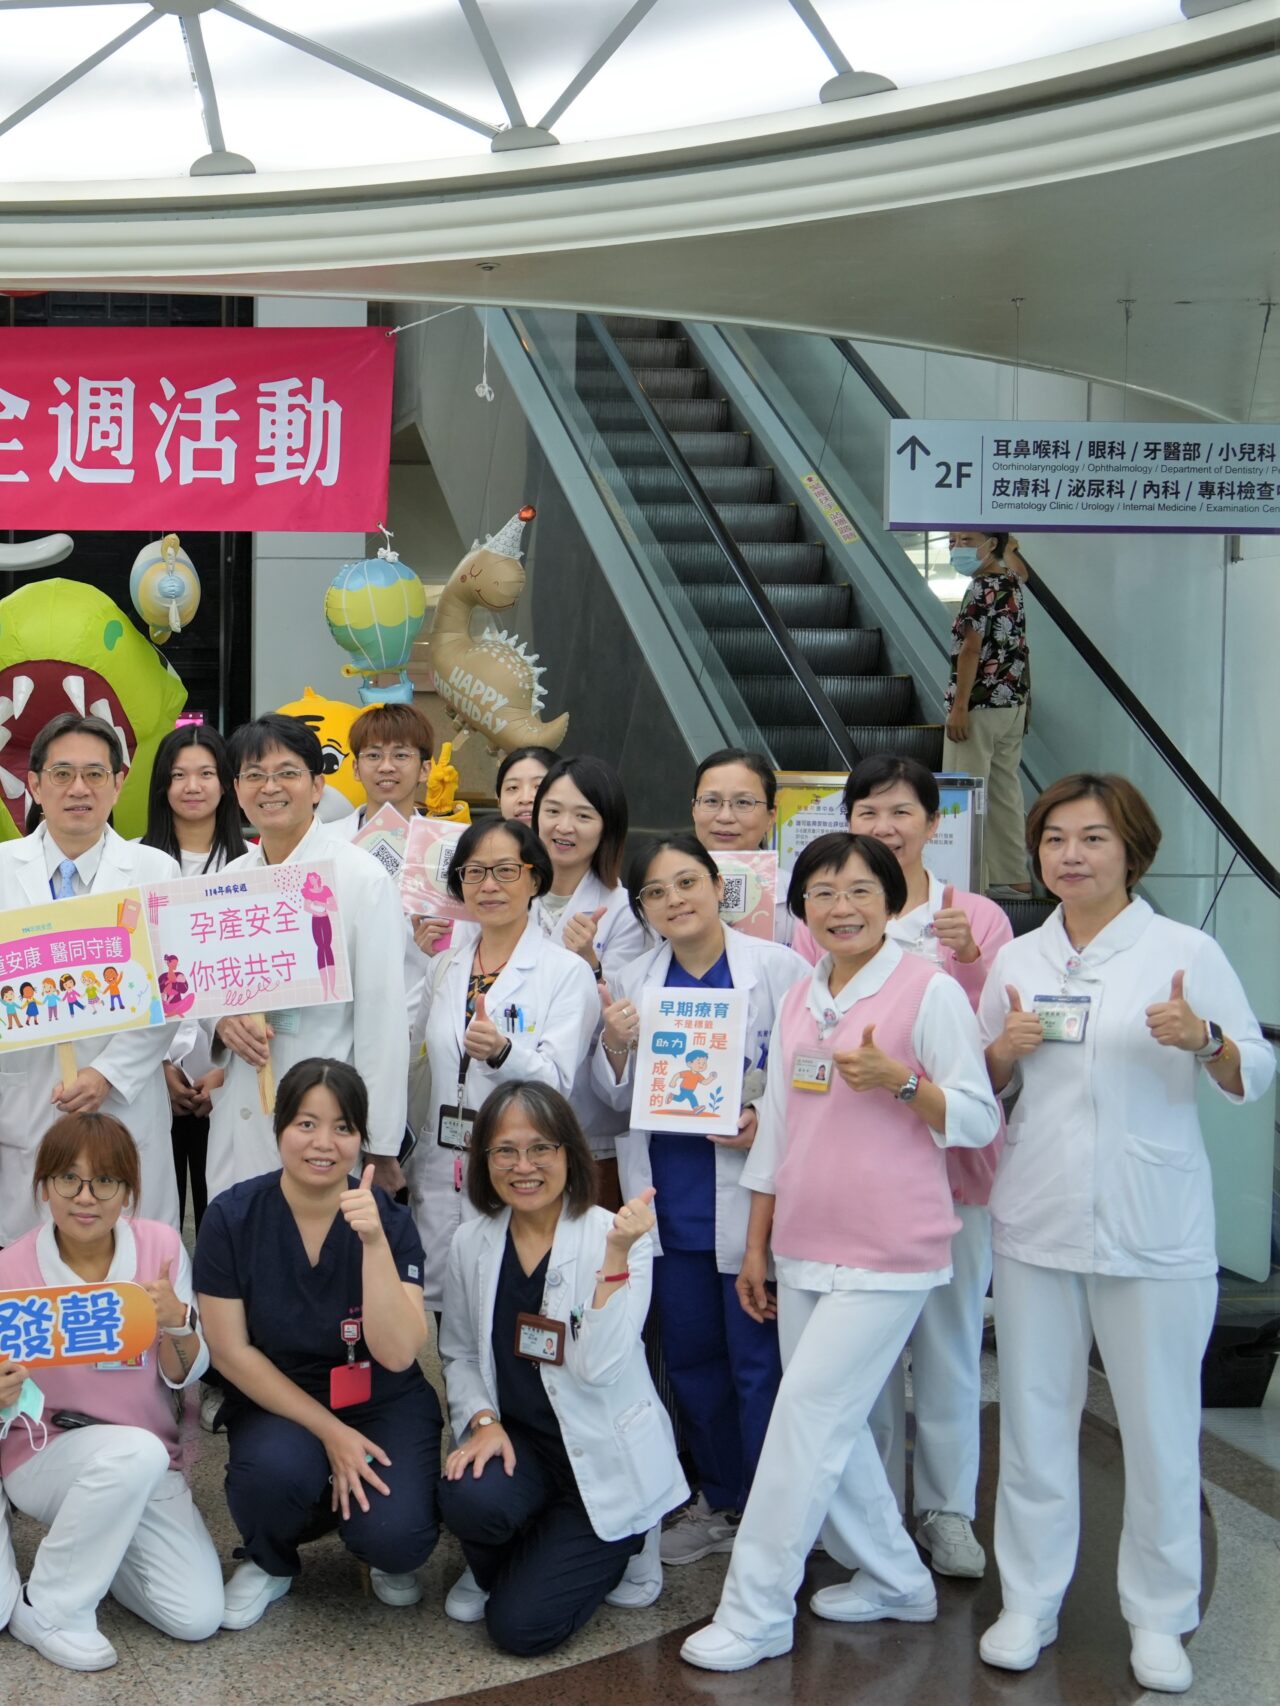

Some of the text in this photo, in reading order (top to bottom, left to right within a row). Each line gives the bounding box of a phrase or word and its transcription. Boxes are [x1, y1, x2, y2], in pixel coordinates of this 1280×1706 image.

[993, 439, 1071, 459] 耳鼻喉科
[1088, 440, 1126, 460] 眼科
[1143, 441, 1201, 461] 牙醫部
[1218, 442, 1276, 462] 小兒科
[935, 461, 973, 488] 2F
[992, 462, 1080, 473] Otorhinolaryngology
[1087, 463, 1153, 474] Ophthalmology
[1160, 464, 1212, 475] Department
[1213, 465, 1223, 474] of
[1224, 465, 1264, 476] Dentistry
[992, 478, 1050, 498] 皮膚科
[1067, 479, 1125, 498] 泌尿科
[1143, 480, 1180, 499] 內科
[1198, 480, 1280, 500] 專科檢查
[991, 501, 1047, 511] Dermatology
[1049, 501, 1073, 510] Clinic
[1081, 502, 1115, 512] Urology
[1122, 503, 1155, 511] Internal
[1157, 503, 1197, 512] Medicine
[1206, 504, 1260, 512] Examination
[449, 666, 509, 711] HAPPY
[433, 670, 508, 735] BIRTHDAY
[190, 901, 299, 944] 孕產安全
[50, 936, 125, 965] 醫同守護
[189, 950, 297, 993] 你我共守
[659, 1000, 730, 1019] 早期療育
[656, 1038, 683, 1049] 助力
[692, 1032, 728, 1050] 而是
[649, 1060, 669, 1107] 成長的
